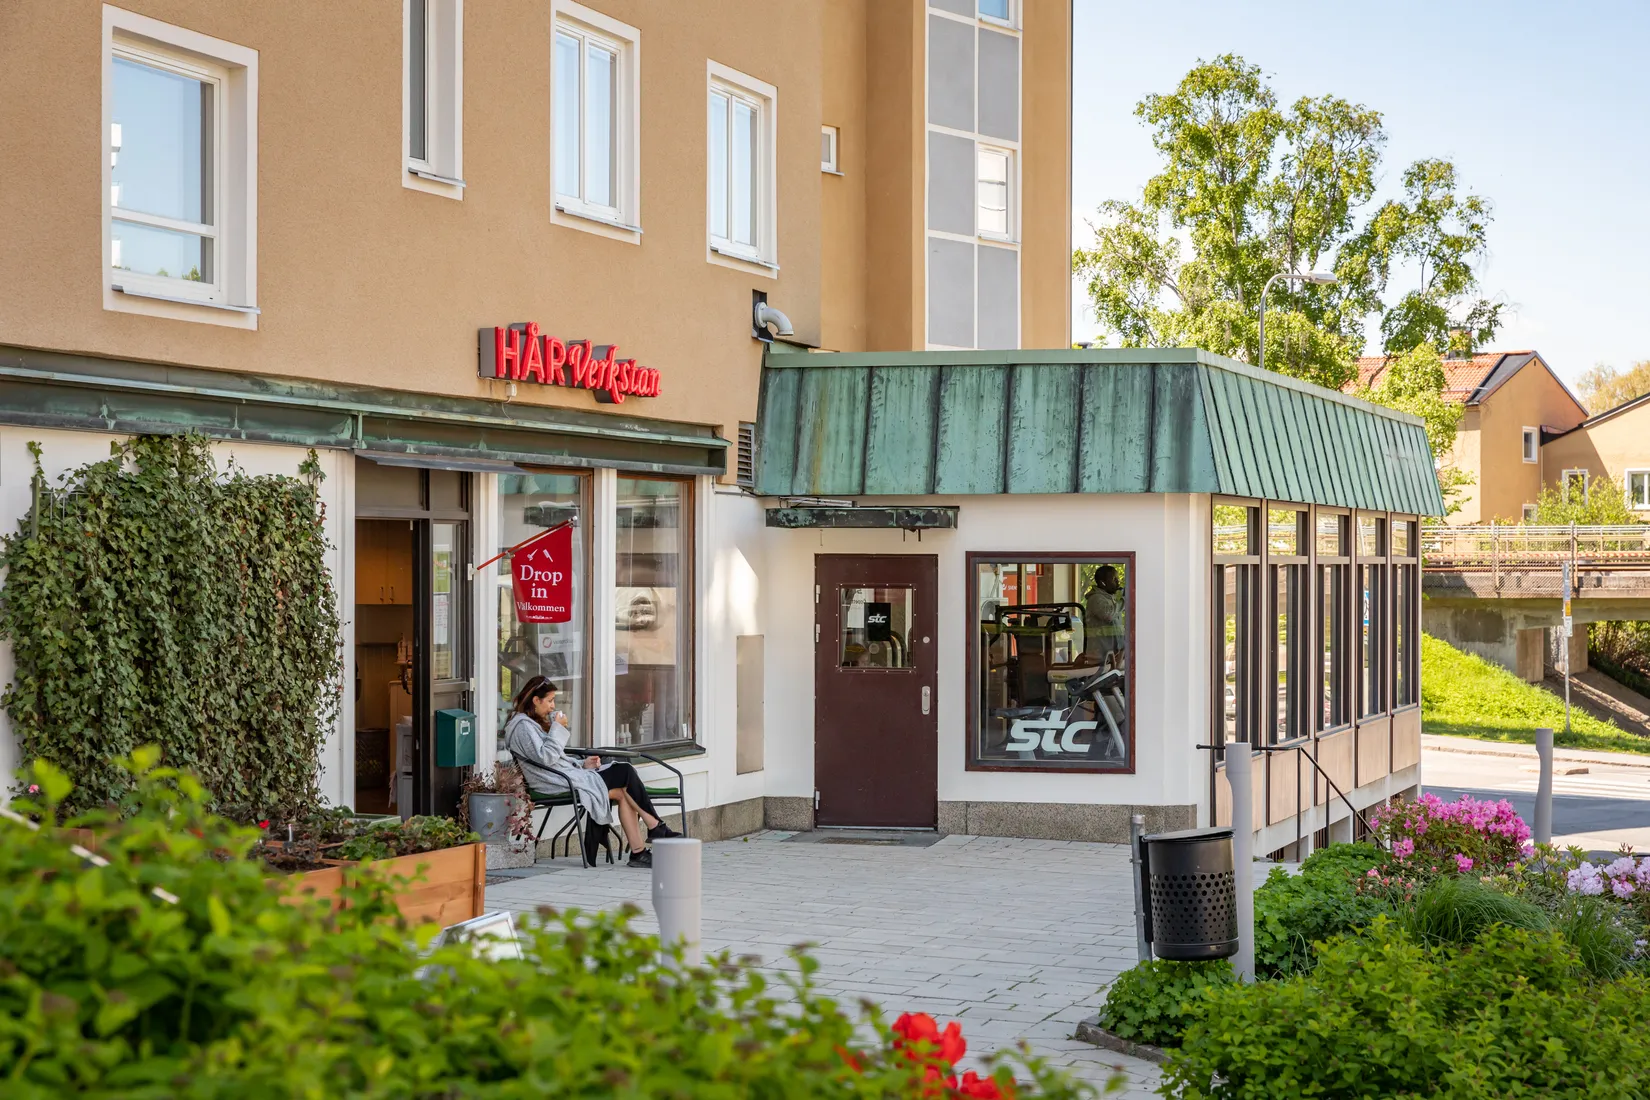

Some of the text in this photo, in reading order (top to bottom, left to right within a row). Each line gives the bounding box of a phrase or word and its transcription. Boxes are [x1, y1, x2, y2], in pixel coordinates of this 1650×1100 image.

[520, 564, 563, 586] Drop
[531, 583, 548, 599] in
[516, 601, 565, 613] Välkommen
